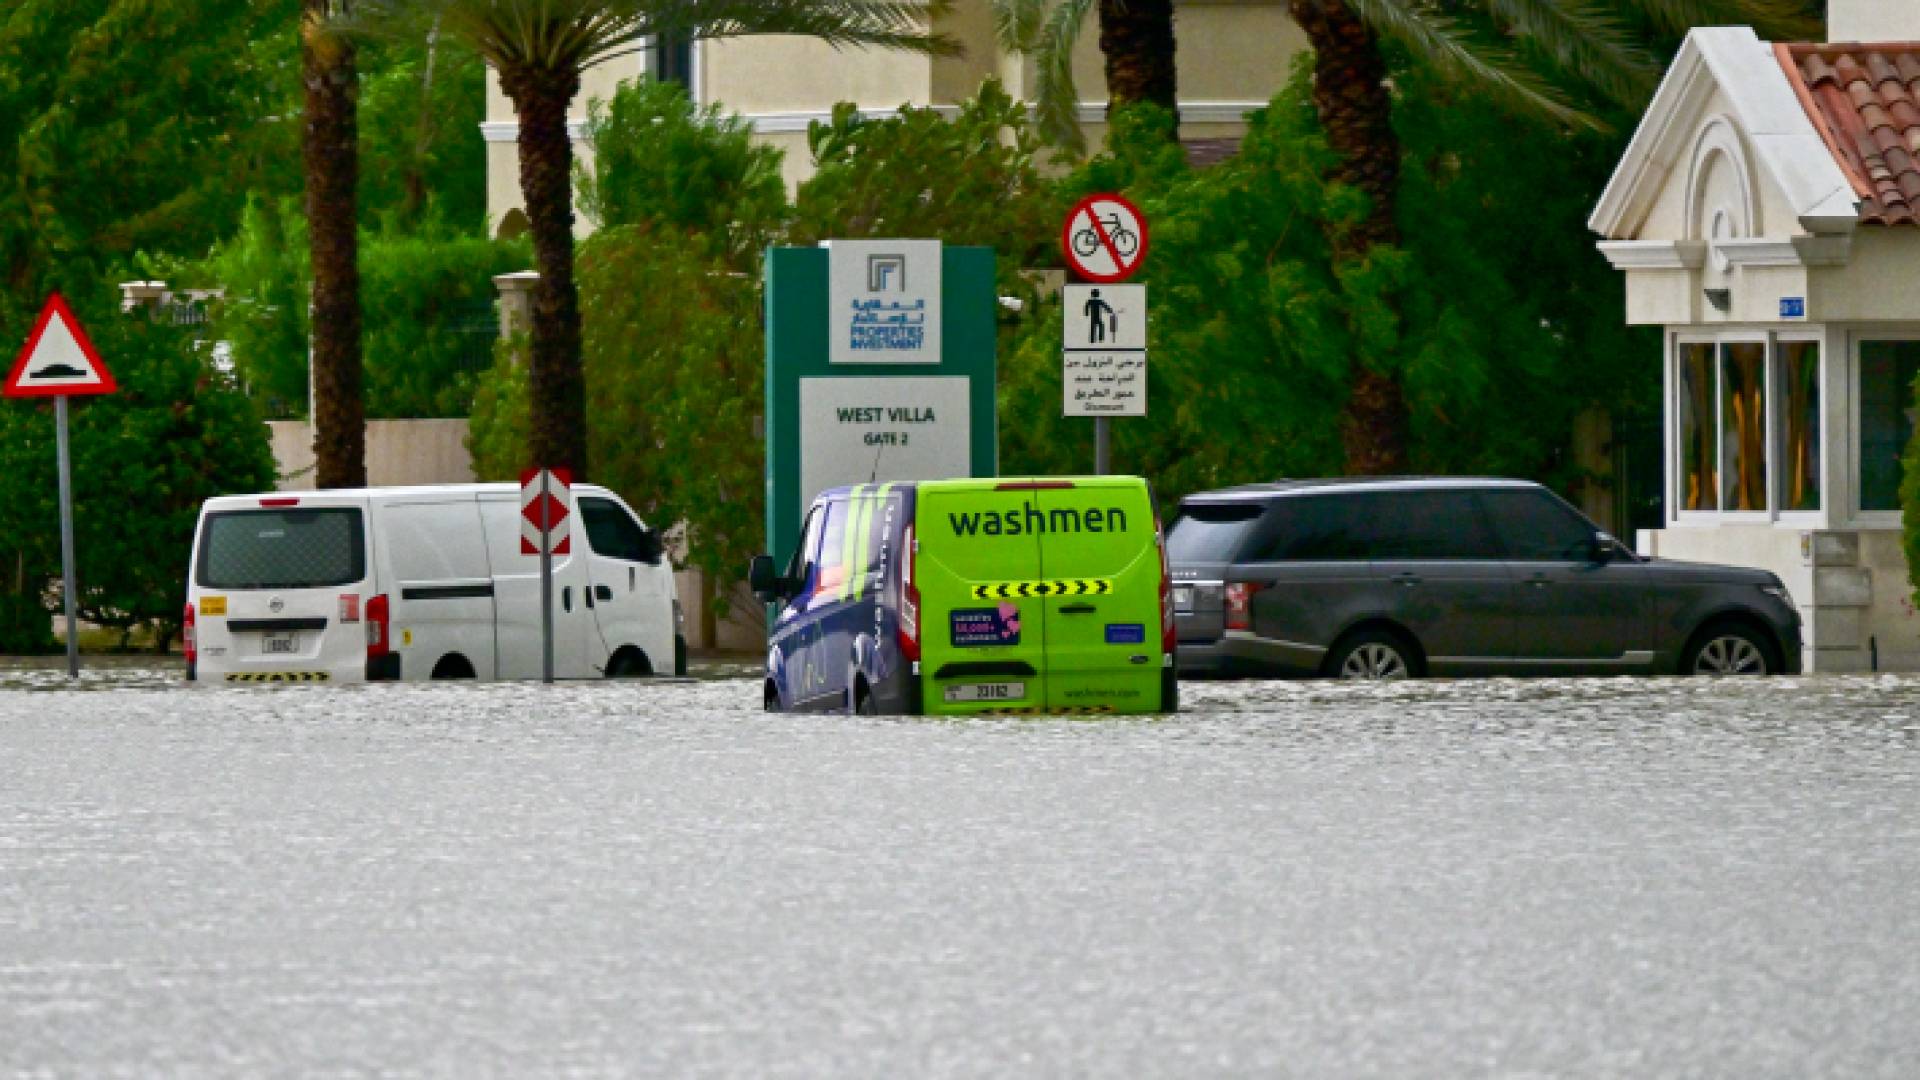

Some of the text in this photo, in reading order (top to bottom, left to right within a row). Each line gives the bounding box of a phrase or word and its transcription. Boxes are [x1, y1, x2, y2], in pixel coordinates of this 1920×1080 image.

[836, 407, 935, 422] WEST VILLA
[863, 431, 908, 446] GATE 2
[948, 501, 1127, 535] washmen
